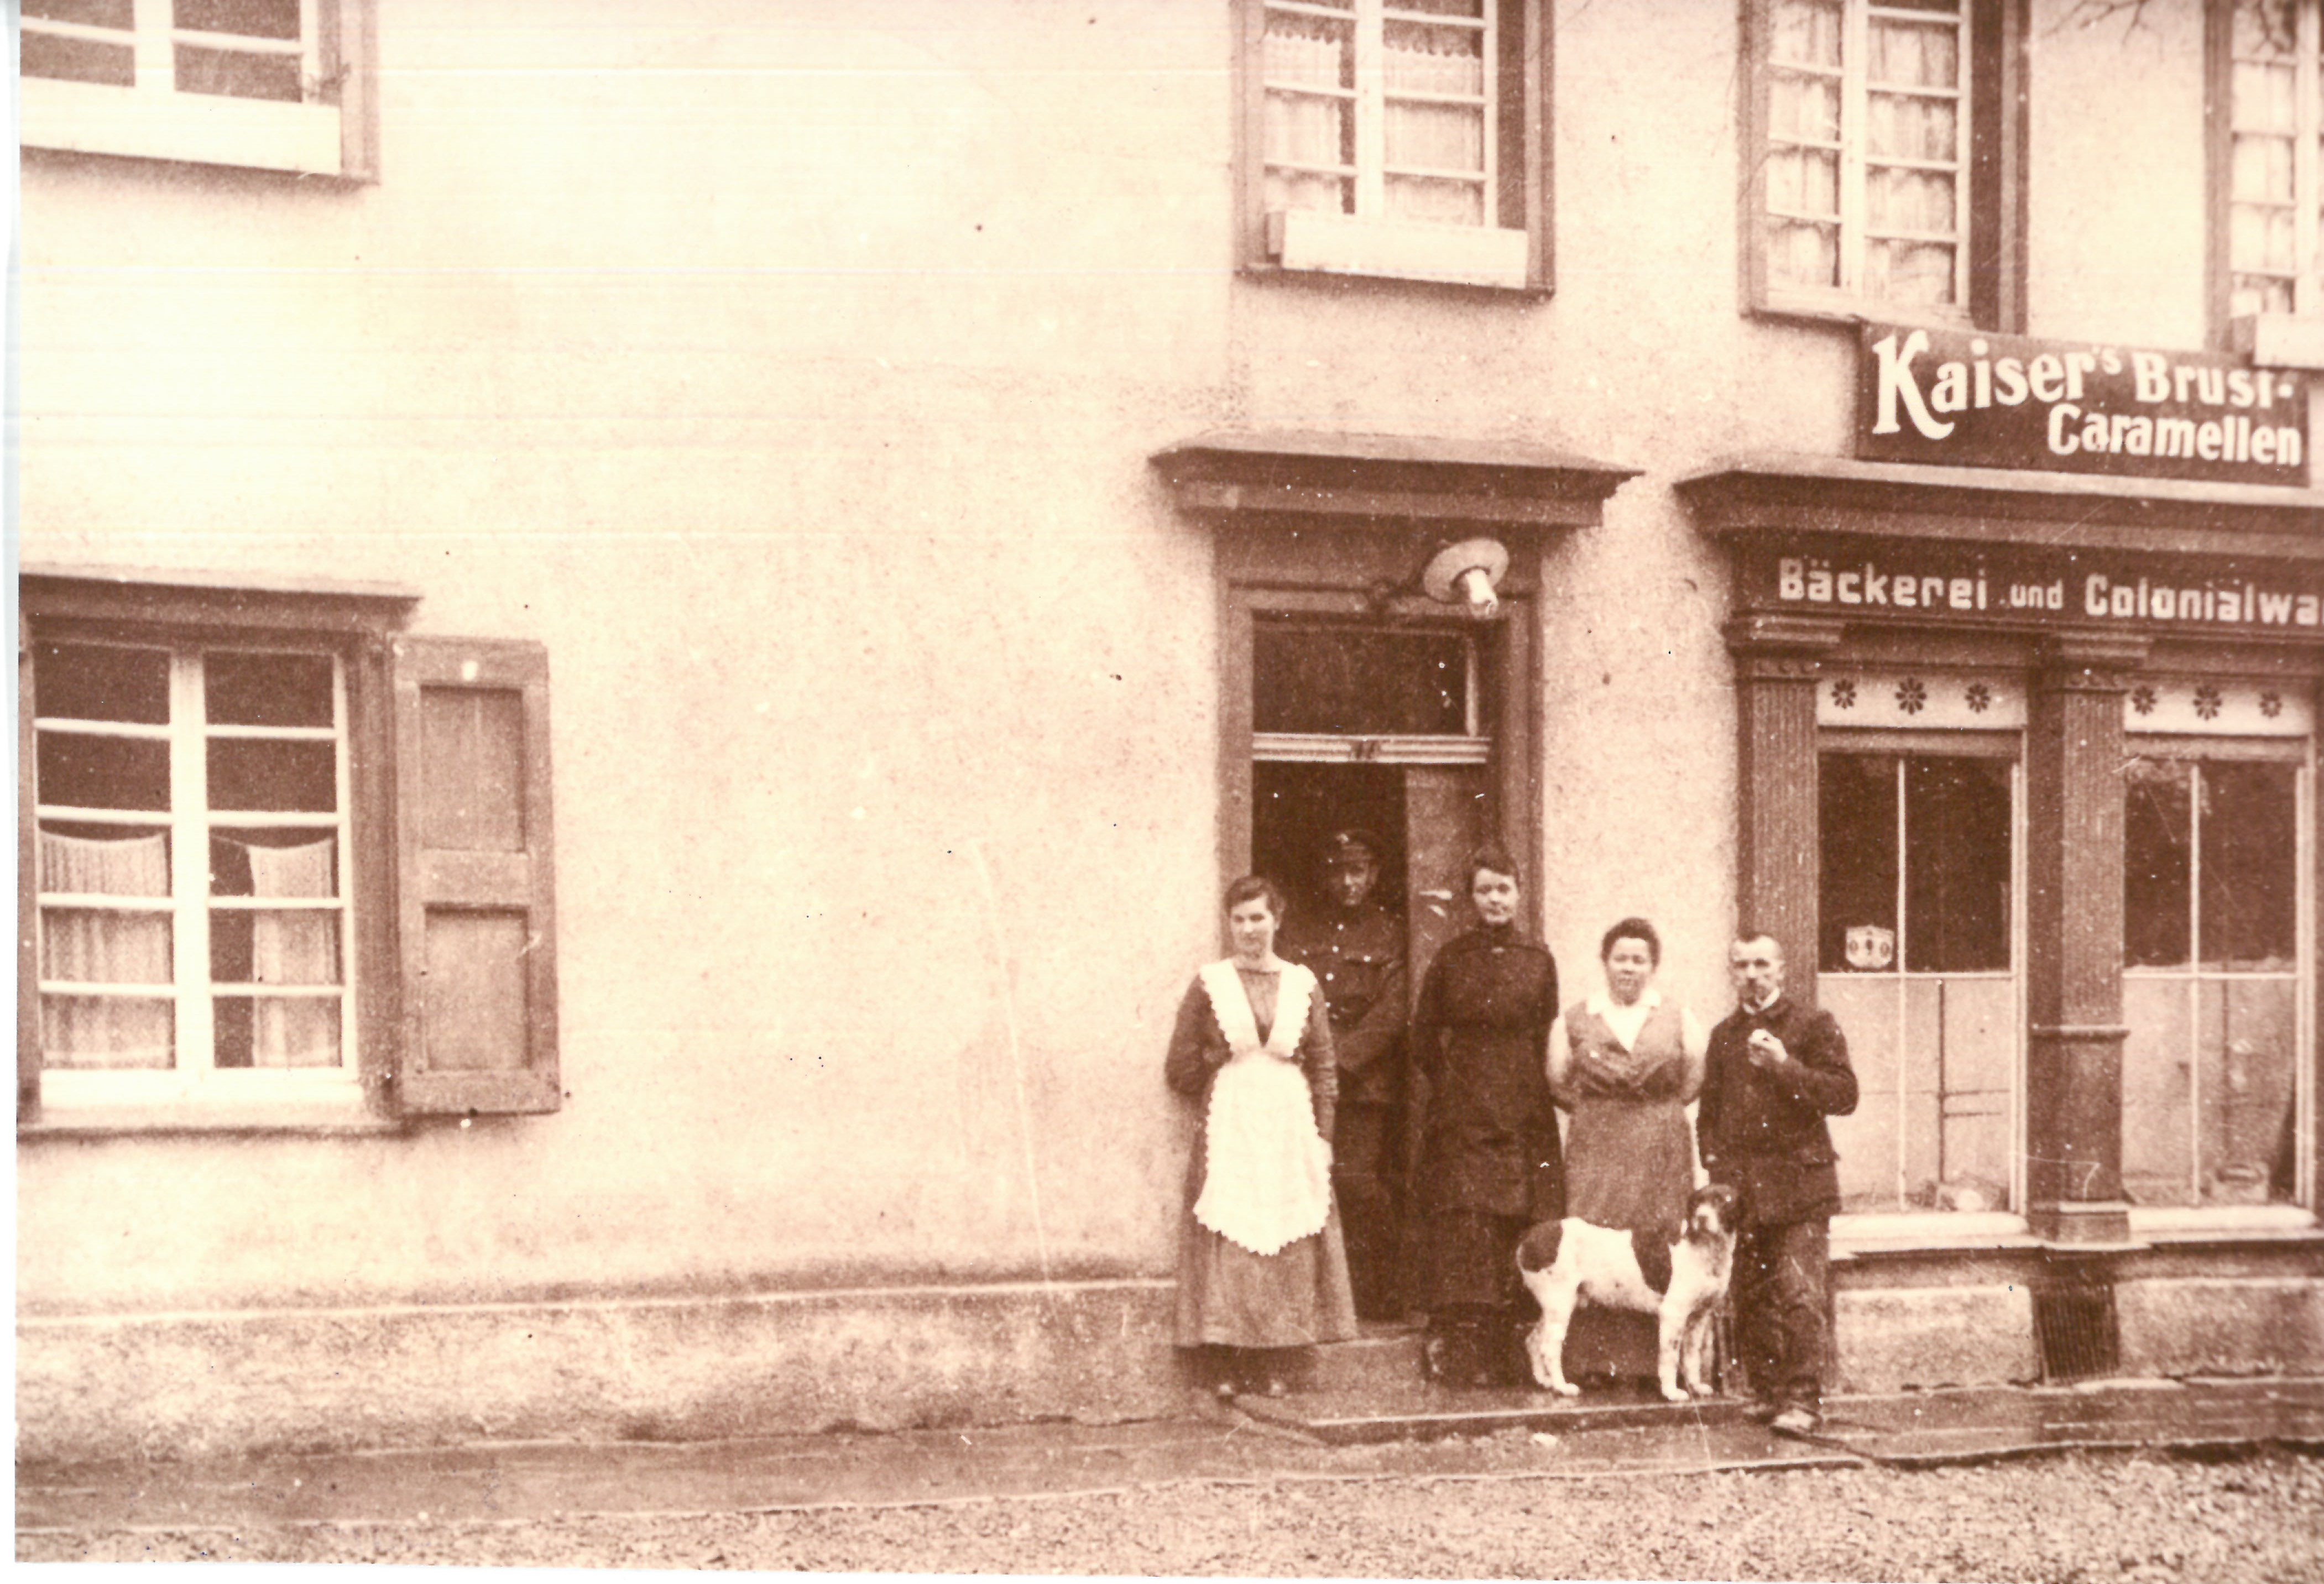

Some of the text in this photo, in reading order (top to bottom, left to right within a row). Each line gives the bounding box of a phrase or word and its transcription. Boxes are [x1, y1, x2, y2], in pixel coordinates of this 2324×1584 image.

[1872, 330, 2122, 440] Kaiser's
[2048, 403, 2302, 466] Caramellen
[1779, 558, 2324, 625] Bäckerei und Colonialwa
